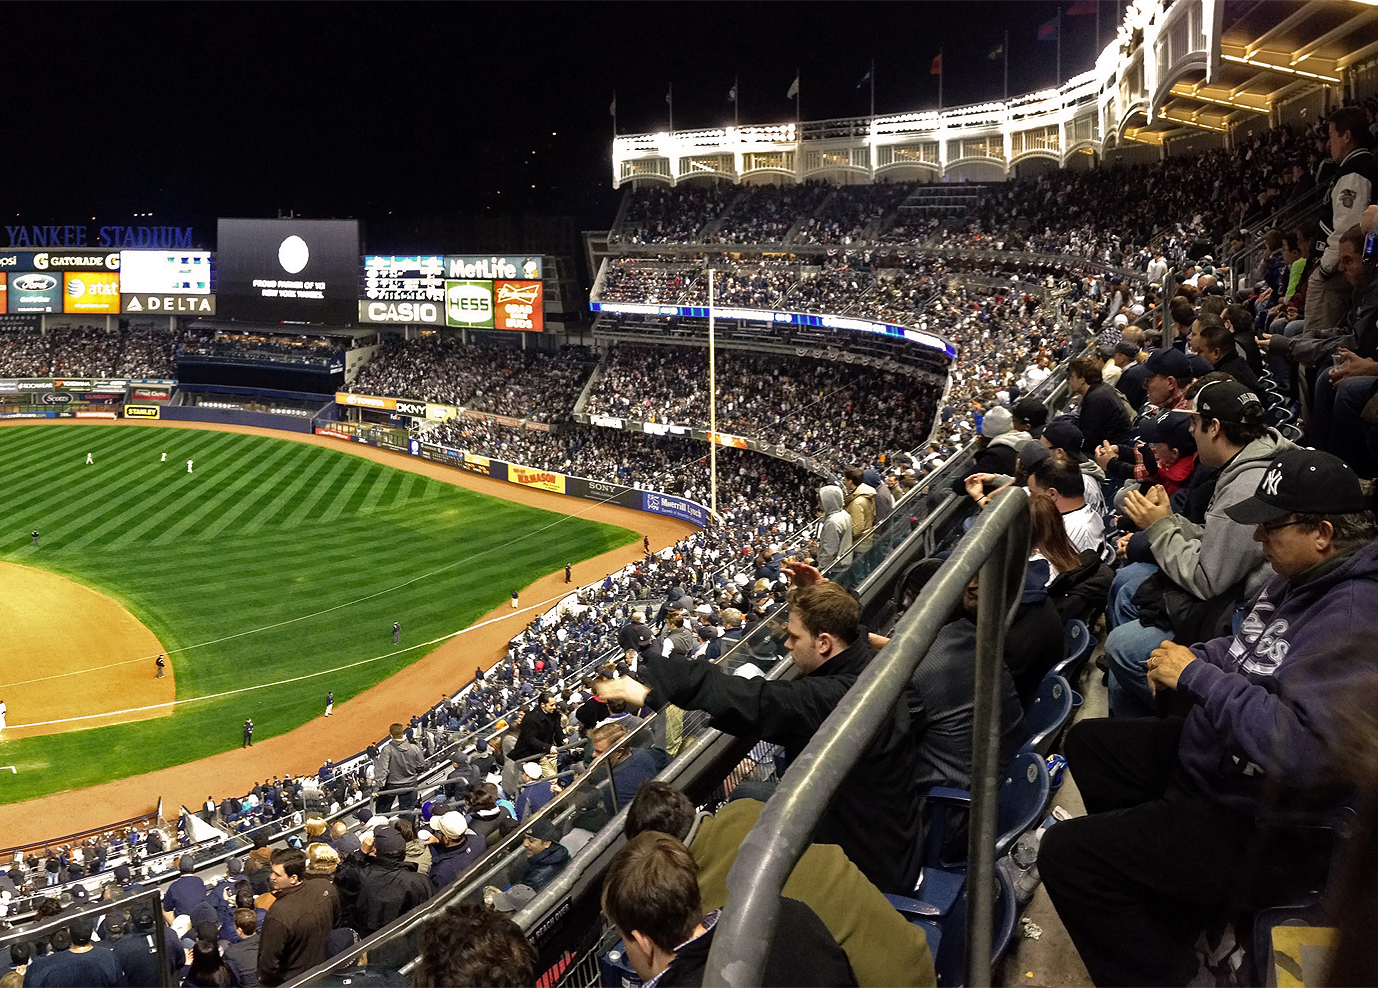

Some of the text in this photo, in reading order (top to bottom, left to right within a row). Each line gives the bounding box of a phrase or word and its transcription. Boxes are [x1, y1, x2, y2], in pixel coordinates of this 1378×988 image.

[5, 225, 193, 248] YANKEE STADIUM
[51, 257, 103, 266] GATORADE
[450, 257, 517, 279] MetLife
[22, 279, 49, 291] Ford
[89, 282, 119, 295] at&t
[147, 296, 212, 311] DELTA
[450, 298, 489, 311] HESS
[368, 302, 437, 322] CASIO
[357, 397, 384, 407] TOYOTA
[396, 402, 426, 415] DKNY
[588, 482, 616, 493] SONY
[1262, 468, 1283, 496] NY
[687, 504, 702, 518] Lynch
[535, 916, 555, 938] REACH
[554, 903, 569, 920] OVER
